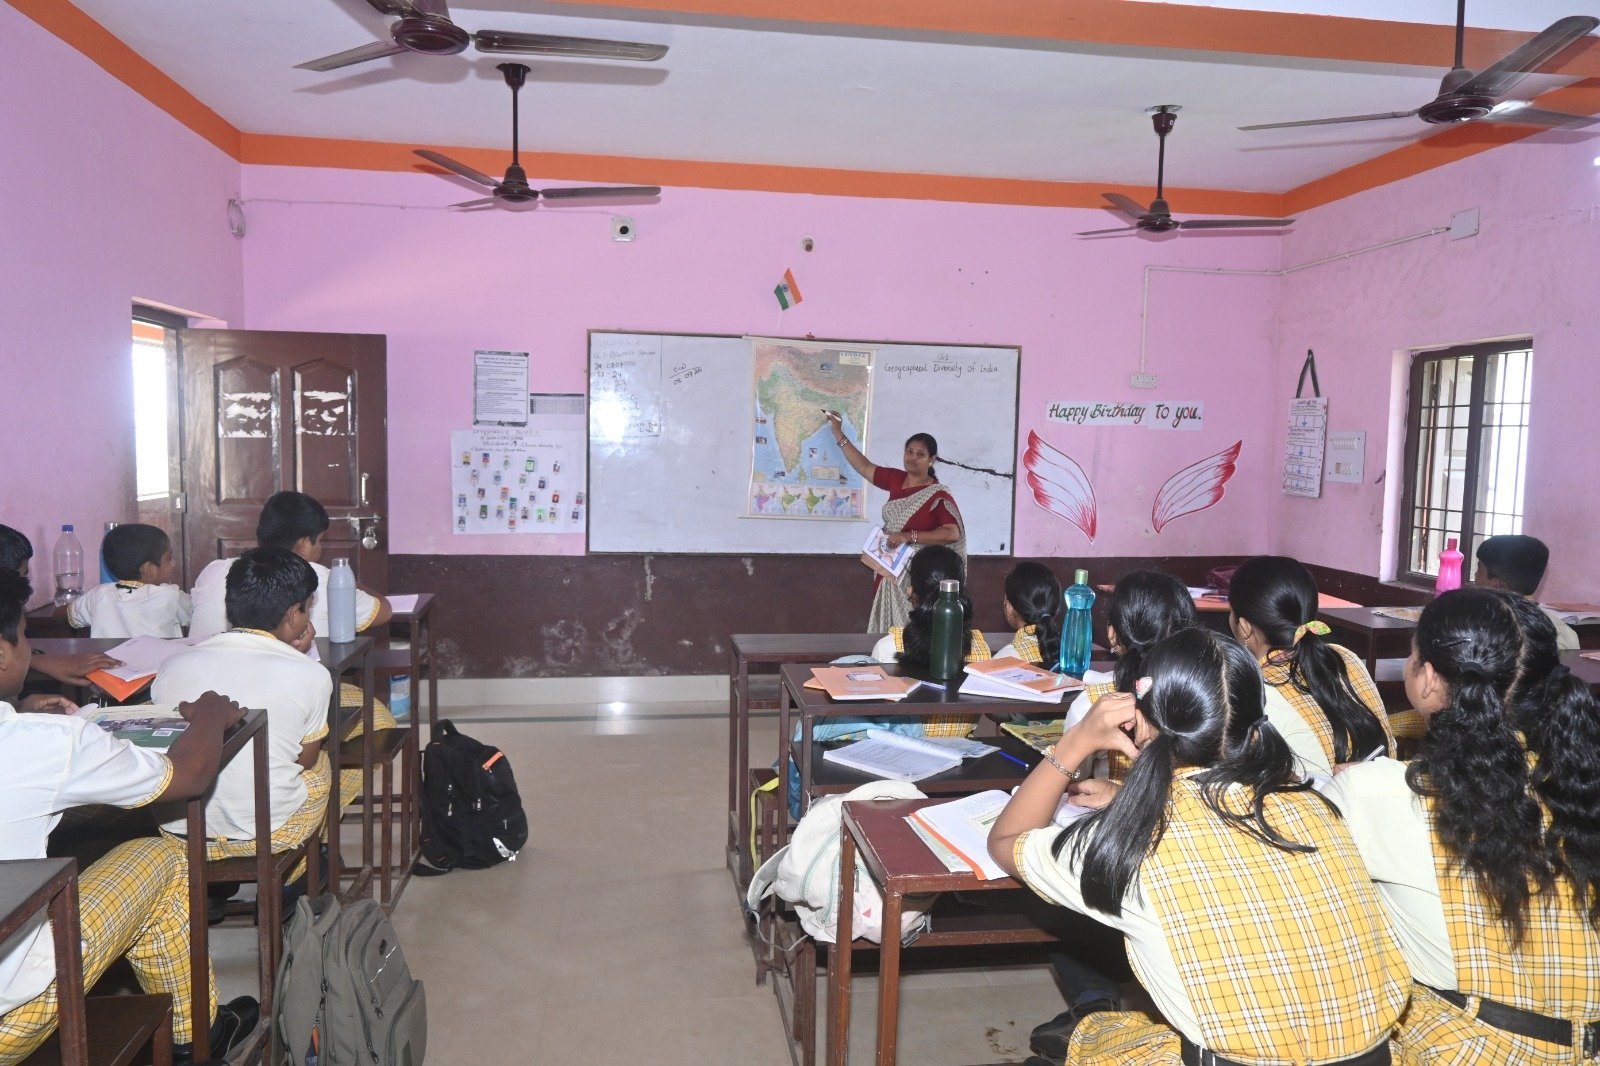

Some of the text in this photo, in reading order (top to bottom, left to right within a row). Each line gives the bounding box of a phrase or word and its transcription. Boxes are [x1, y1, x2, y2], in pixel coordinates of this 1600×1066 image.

[933, 363, 962, 379] Diversity
[980, 363, 999, 373] India
[1049, 403, 1090, 425] Happy
[1090, 403, 1147, 425] Birthday
[1155, 404, 1170, 420] To
